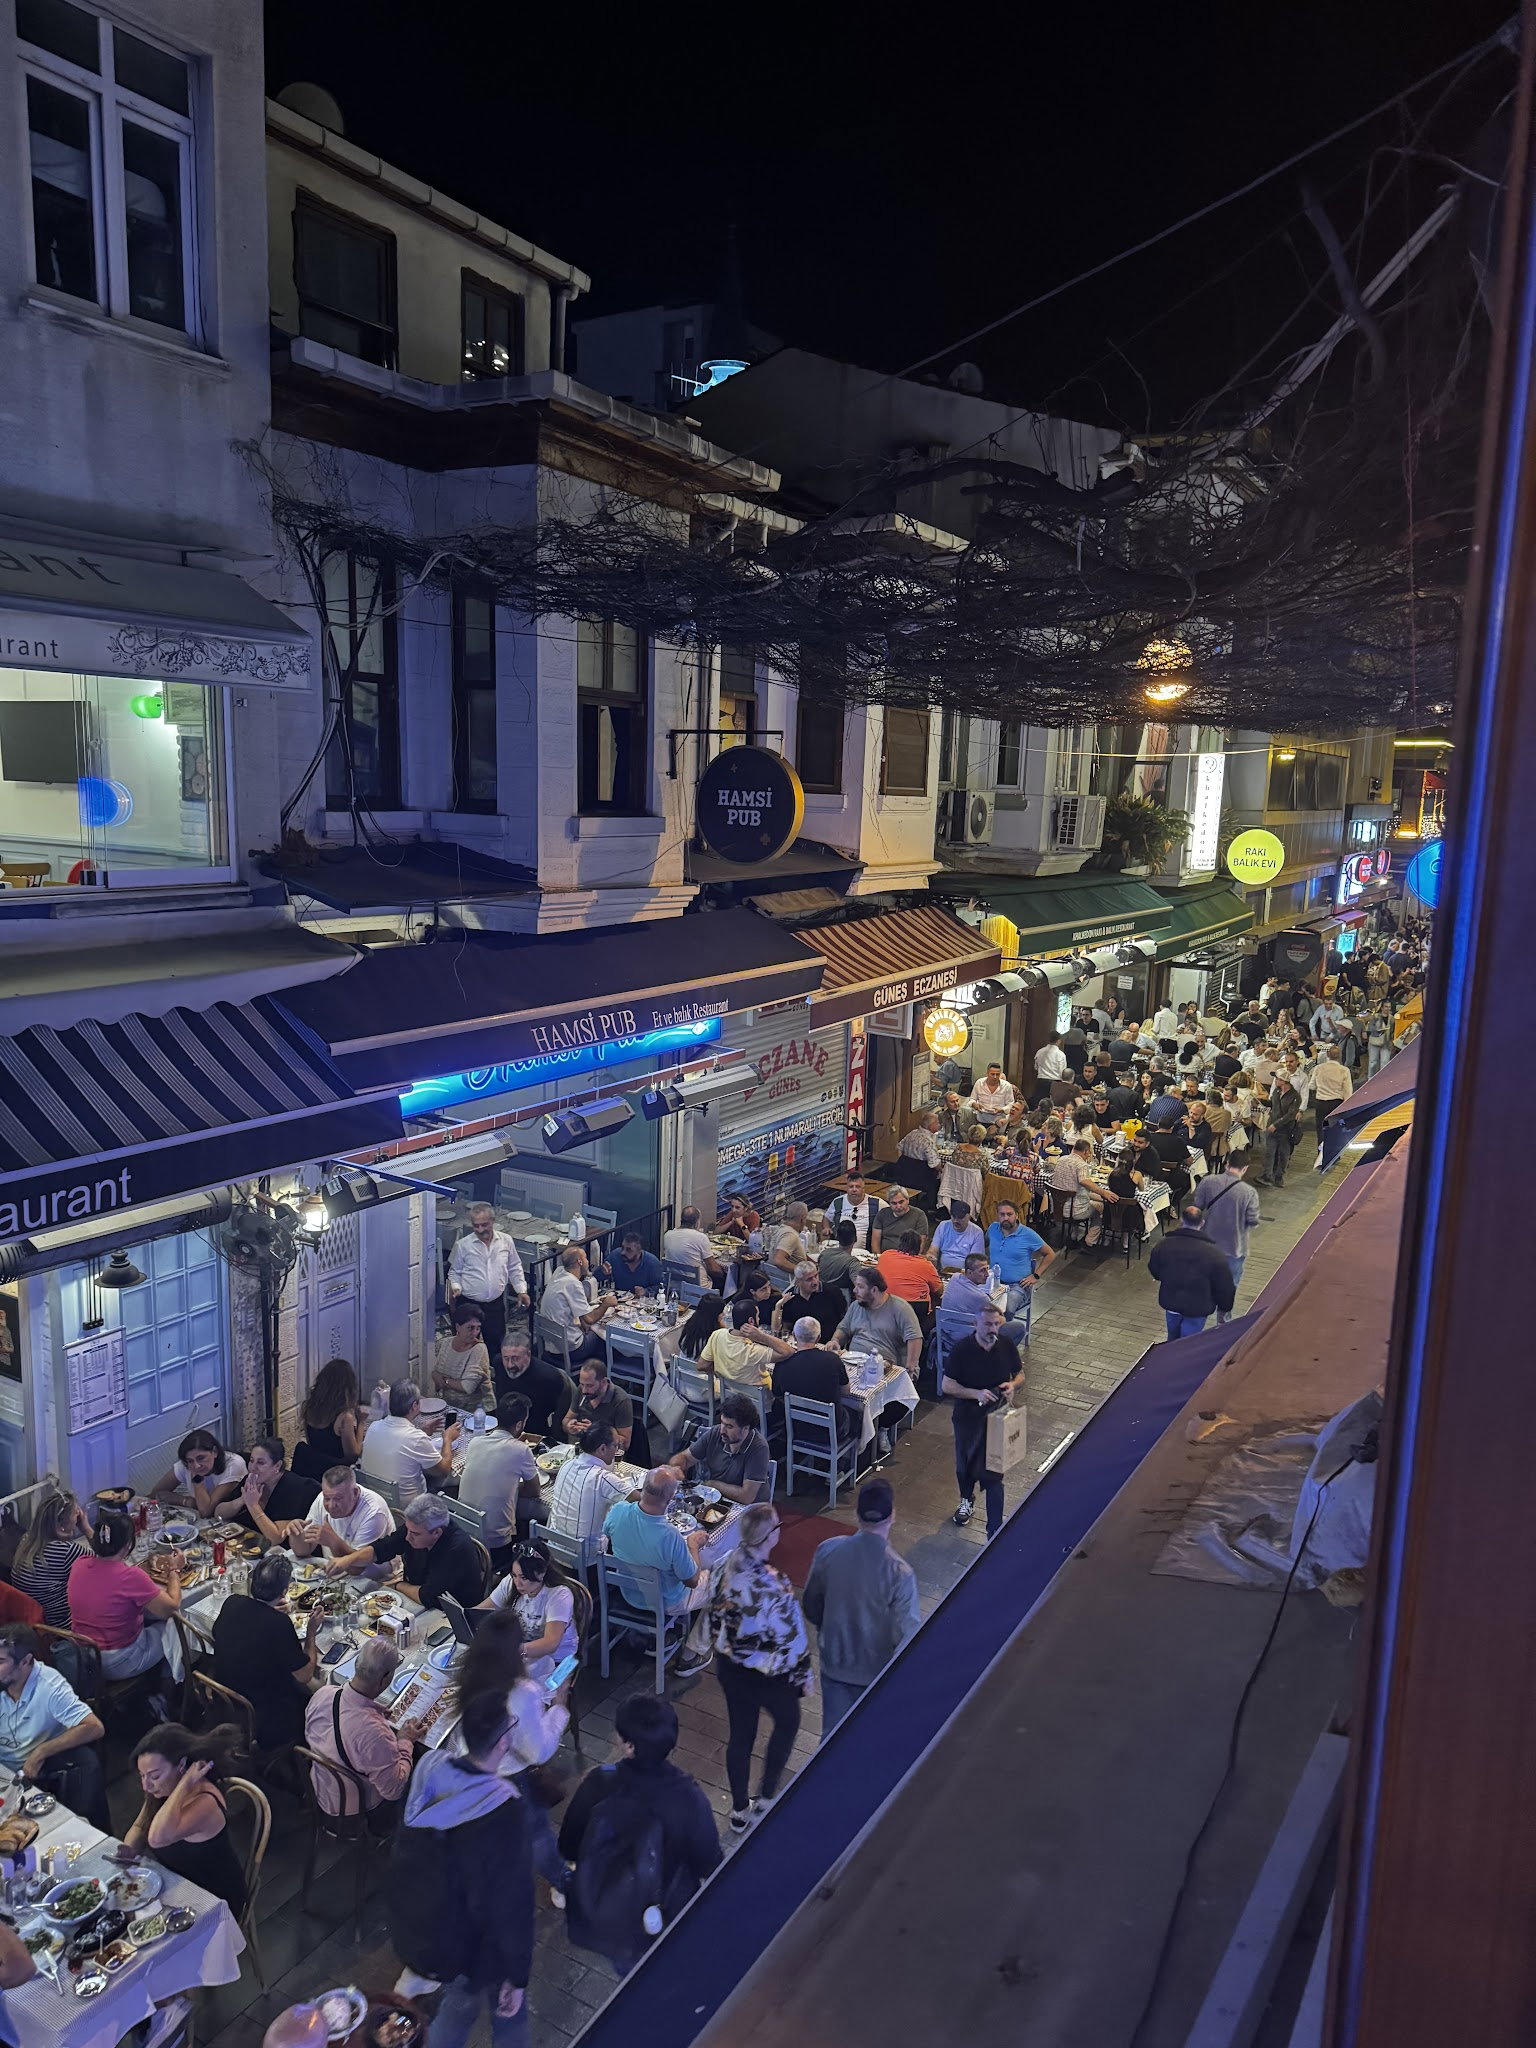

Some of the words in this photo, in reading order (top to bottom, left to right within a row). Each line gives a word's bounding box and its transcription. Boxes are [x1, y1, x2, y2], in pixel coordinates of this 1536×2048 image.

[717, 787, 772, 808] HAMSİ
[727, 809, 761, 827] PUB
[1245, 847, 1267, 857] RAKI
[1233, 858, 1260, 868] BALIK
[1261, 858, 1277, 868] EVİ
[873, 982, 908, 1008] GÜNEŞ
[913, 966, 958, 997] ECZANESİ
[530, 1012, 596, 1053] HAMSİ
[599, 1009, 637, 1040] PUB
[652, 1010, 663, 1029] Et
[663, 1012, 673, 1026] ve
[672, 1004, 692, 1024] balık
[692, 997, 729, 1020] Restaurant
